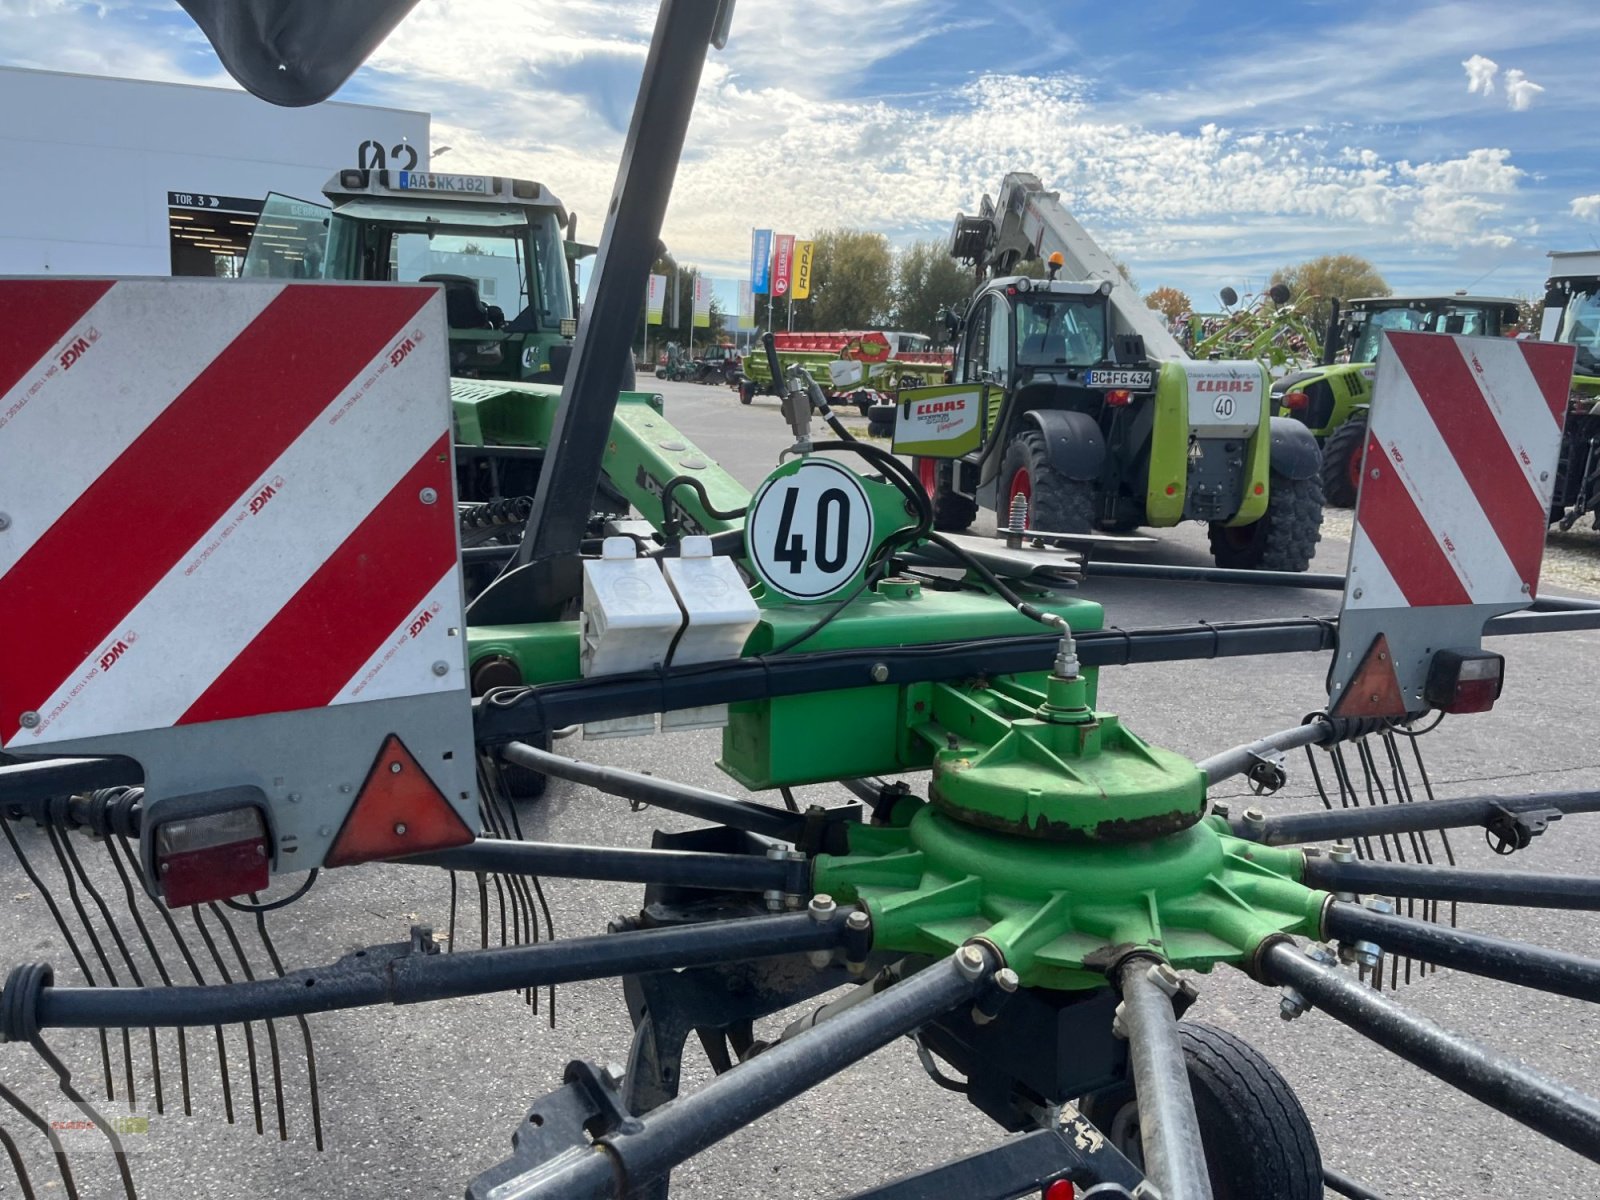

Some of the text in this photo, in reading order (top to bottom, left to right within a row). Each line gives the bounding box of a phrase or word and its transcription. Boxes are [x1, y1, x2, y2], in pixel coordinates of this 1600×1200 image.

[409, 174, 484, 193] AA WK 182
[174, 193, 205, 206] TOR 3
[799, 243, 812, 289] ROPA
[60, 338, 90, 370] WGF
[391, 339, 415, 367] WGF
[1472, 357, 1483, 373] WGF
[1091, 371, 1150, 384] BC FG 434
[1196, 380, 1254, 392] CLAAS
[917, 400, 965, 415] CLAAS
[1215, 401, 1233, 416] 40
[1391, 447, 1403, 462] WGF
[1520, 450, 1530, 465] WGF
[250, 486, 276, 515] WGF
[773, 487, 851, 574] 40
[1444, 537, 1455, 552] WGF
[410, 611, 433, 638] WGF
[100, 641, 128, 672] WGF
[85, 668, 99, 680] DIN
[70, 680, 87, 697] 11030
[48, 700, 69, 720] TPESC
